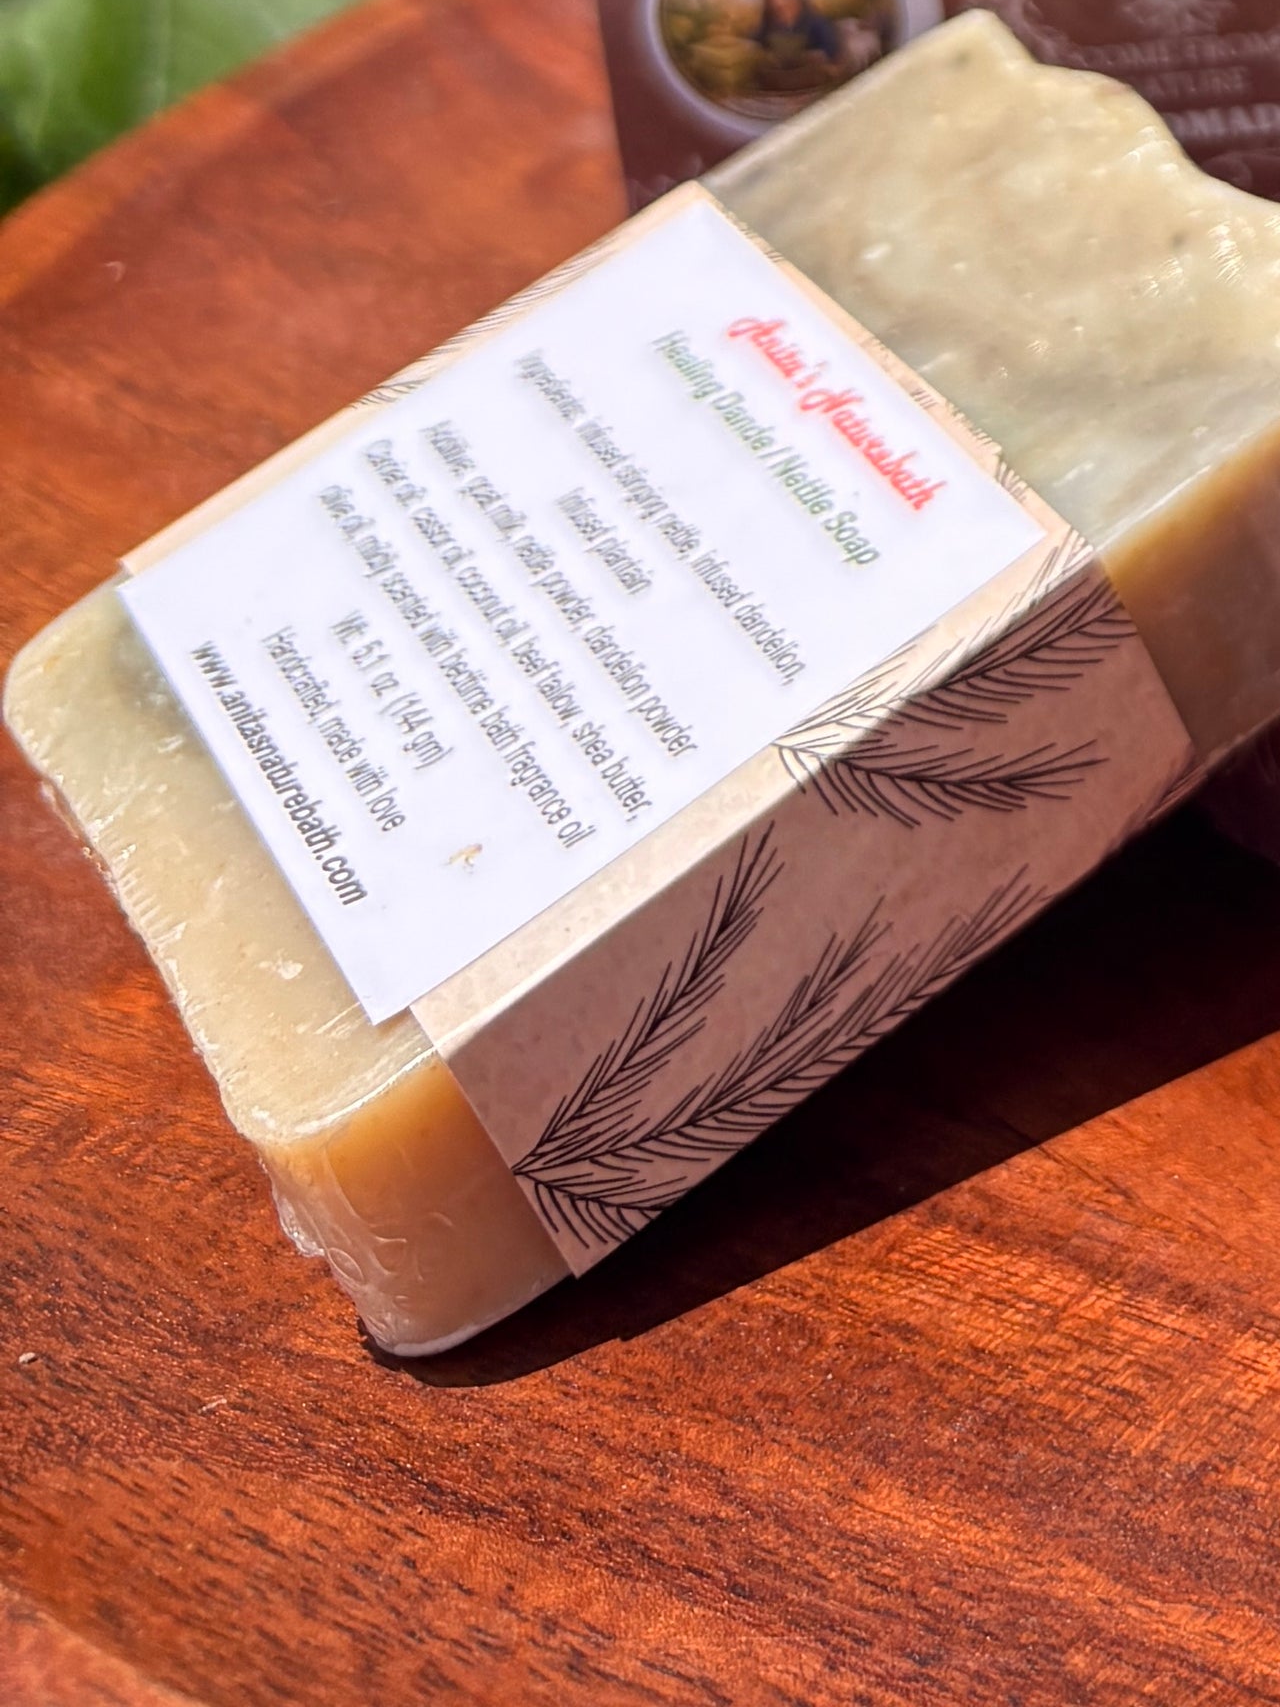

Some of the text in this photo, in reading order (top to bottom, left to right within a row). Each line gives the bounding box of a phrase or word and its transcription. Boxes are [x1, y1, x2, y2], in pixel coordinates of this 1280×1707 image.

[652, 330, 724, 403] Healing
[708, 391, 774, 453] Dande
[767, 454, 834, 518] Nettle
[820, 510, 880, 569] Soap
[585, 537, 652, 597] plantain
[653, 512, 701, 561] nettle,
[732, 603, 806, 686] dandelion,
[416, 624, 458, 658] with
[530, 570, 595, 633] powder,
[581, 625, 651, 701] dandelion
[626, 694, 698, 758] powder
[367, 670, 400, 699] oz
[436, 648, 494, 716] bedtime
[377, 691, 434, 736] (144
[477, 705, 528, 752] bath
[509, 635, 559, 679] beef
[534, 669, 583, 729] tallow,
[569, 720, 615, 768] shea
[599, 755, 653, 824] butter,
[316, 715, 365, 765] made
[401, 730, 454, 771] gm)
[192, 642, 365, 904] www.anitasnaturebath.com
[344, 758, 389, 798] with
[503, 741, 572, 826] fragrance
[364, 787, 406, 833] love
[555, 819, 597, 850] oil
